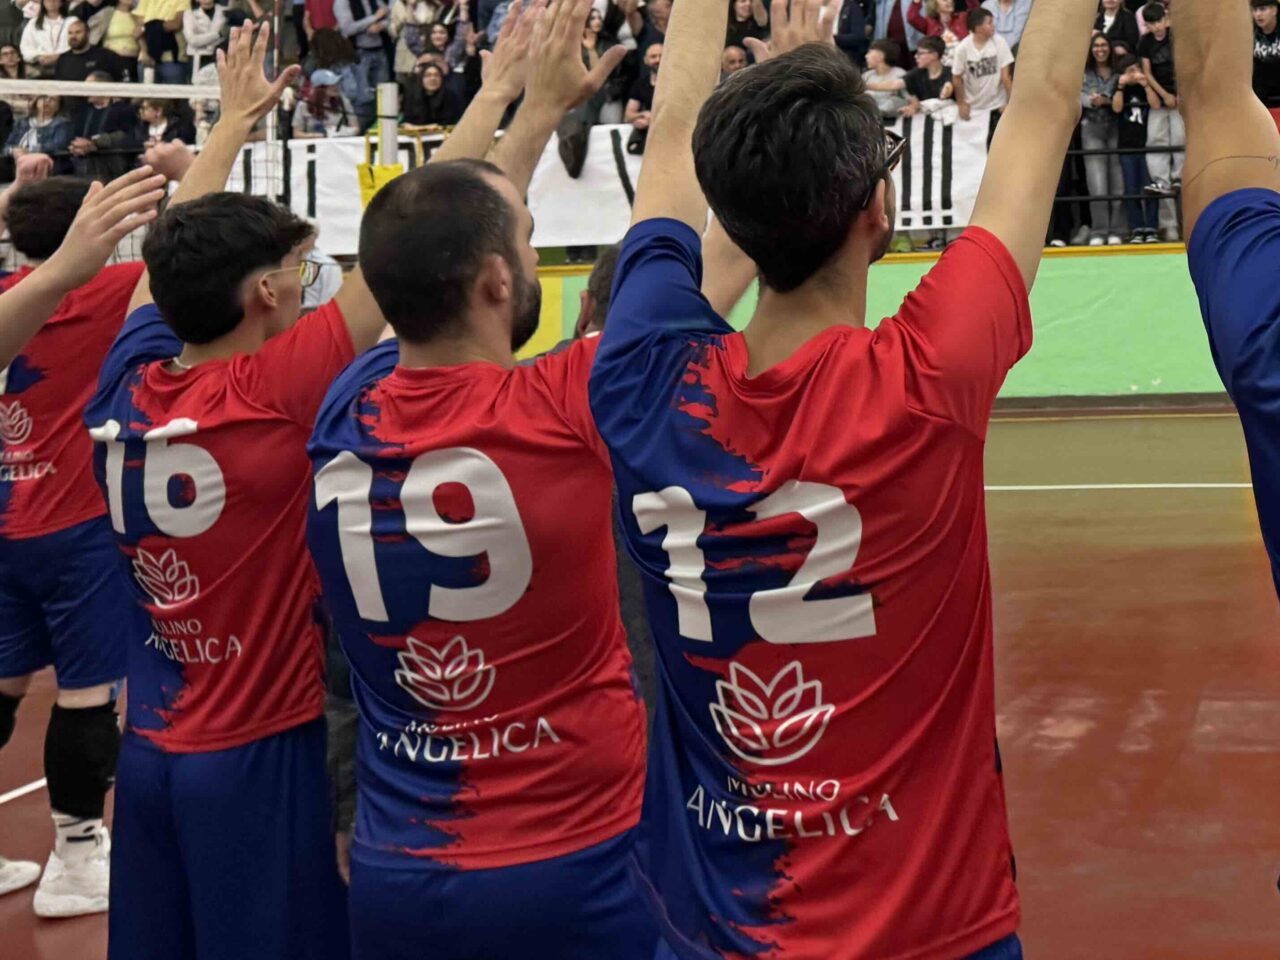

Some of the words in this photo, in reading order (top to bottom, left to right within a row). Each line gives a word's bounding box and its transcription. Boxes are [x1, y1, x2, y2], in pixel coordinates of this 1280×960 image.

[89, 417, 226, 537] 16
[315, 447, 533, 622] 19
[632, 479, 877, 643] 12
[152, 618, 202, 635] ULINO
[686, 783, 899, 842] ANGELICA
